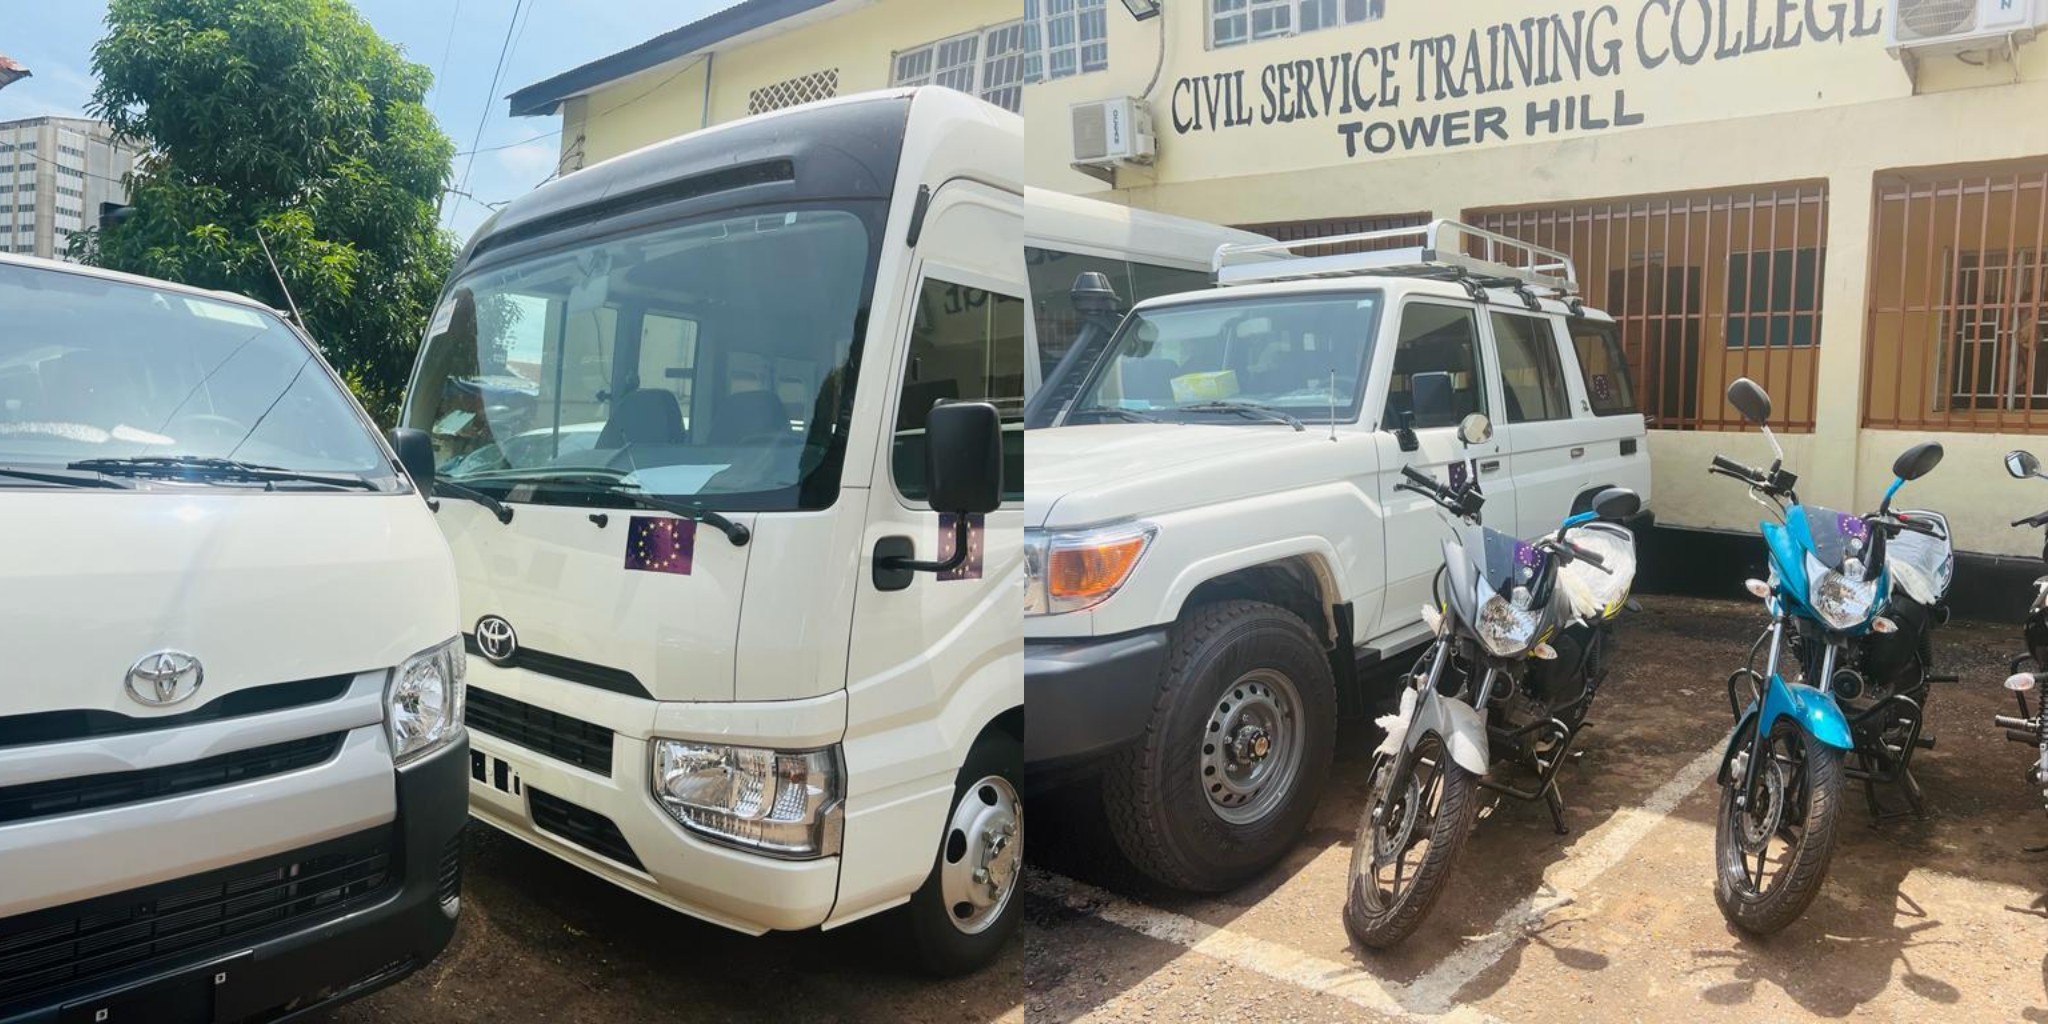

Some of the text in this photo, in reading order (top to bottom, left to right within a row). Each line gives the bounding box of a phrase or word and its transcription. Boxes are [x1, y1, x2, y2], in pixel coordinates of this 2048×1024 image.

[1172, 70, 1253, 134] CIVIL
[1260, 42, 1401, 125] SERVICE
[1410, 6, 1623, 103] TRAINING
[1337, 90, 1645, 158] TOWER HILL
